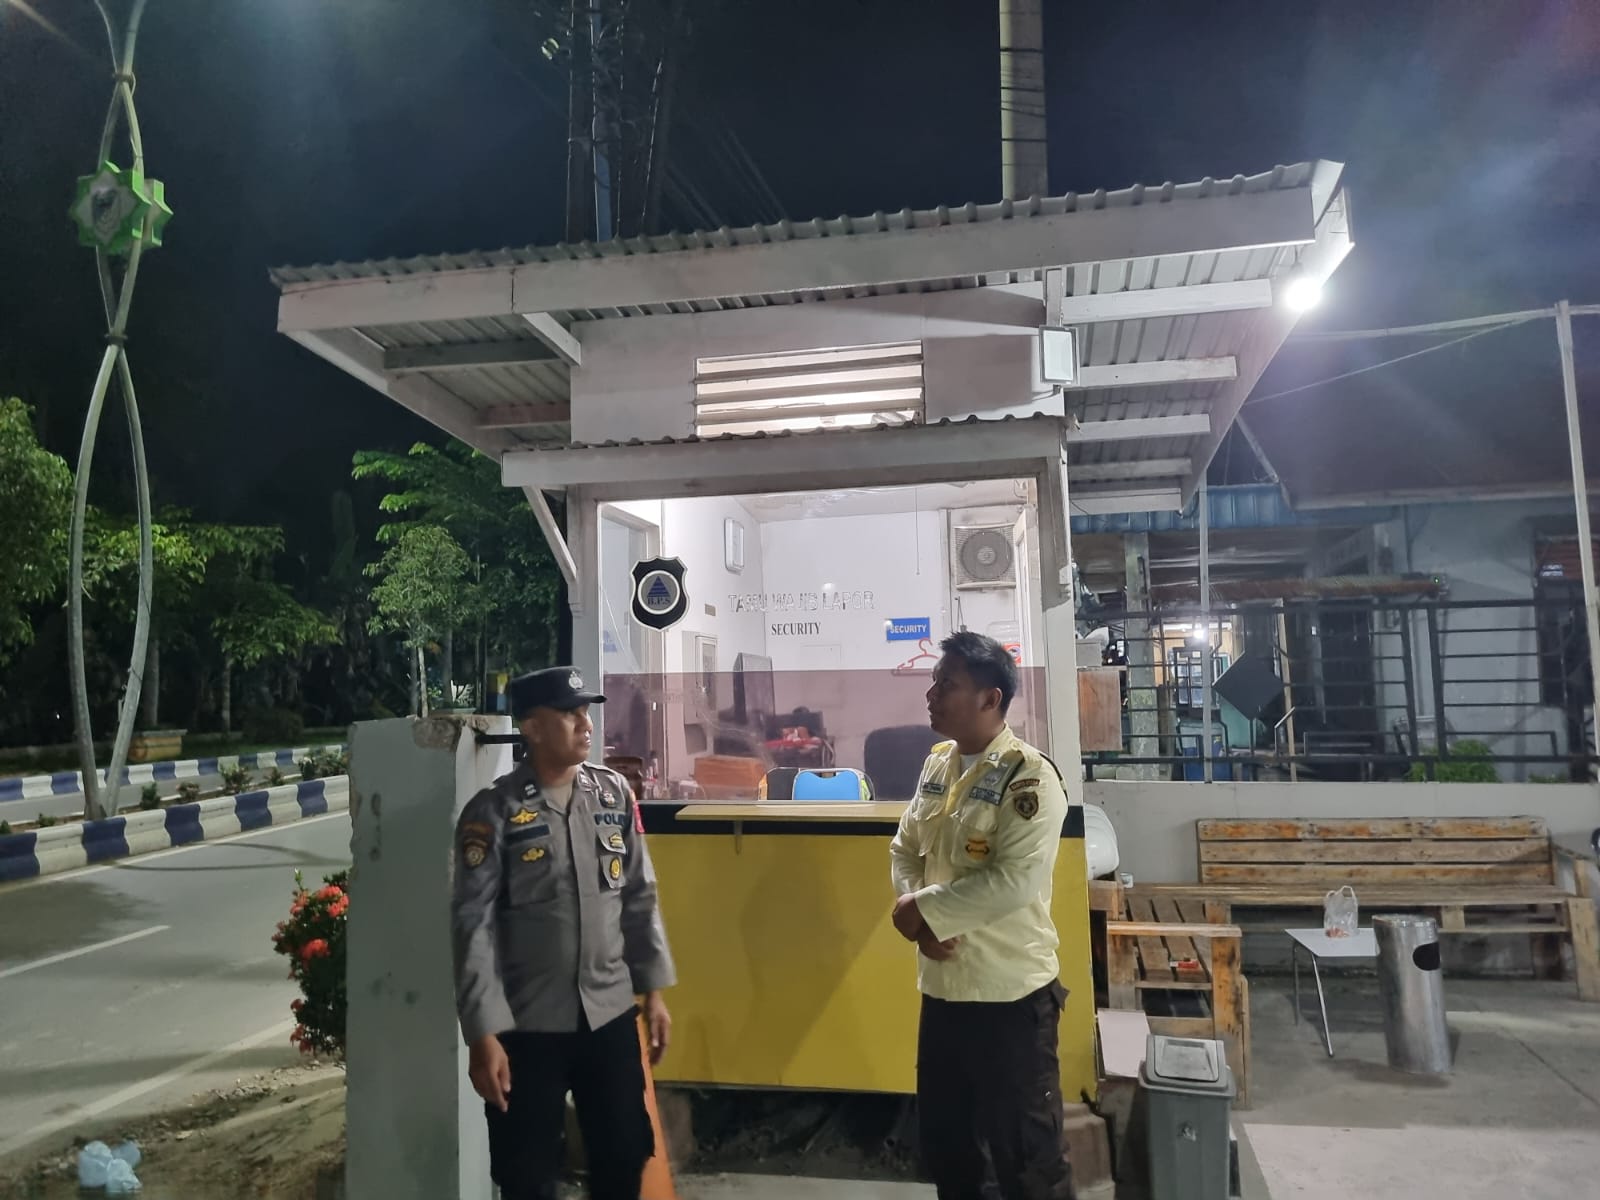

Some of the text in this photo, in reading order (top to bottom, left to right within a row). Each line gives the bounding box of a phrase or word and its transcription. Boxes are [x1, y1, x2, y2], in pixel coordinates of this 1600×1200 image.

[822, 591, 875, 611] LAPOR
[771, 622, 821, 636] SECURITY
[889, 624, 927, 635] SECURITY
